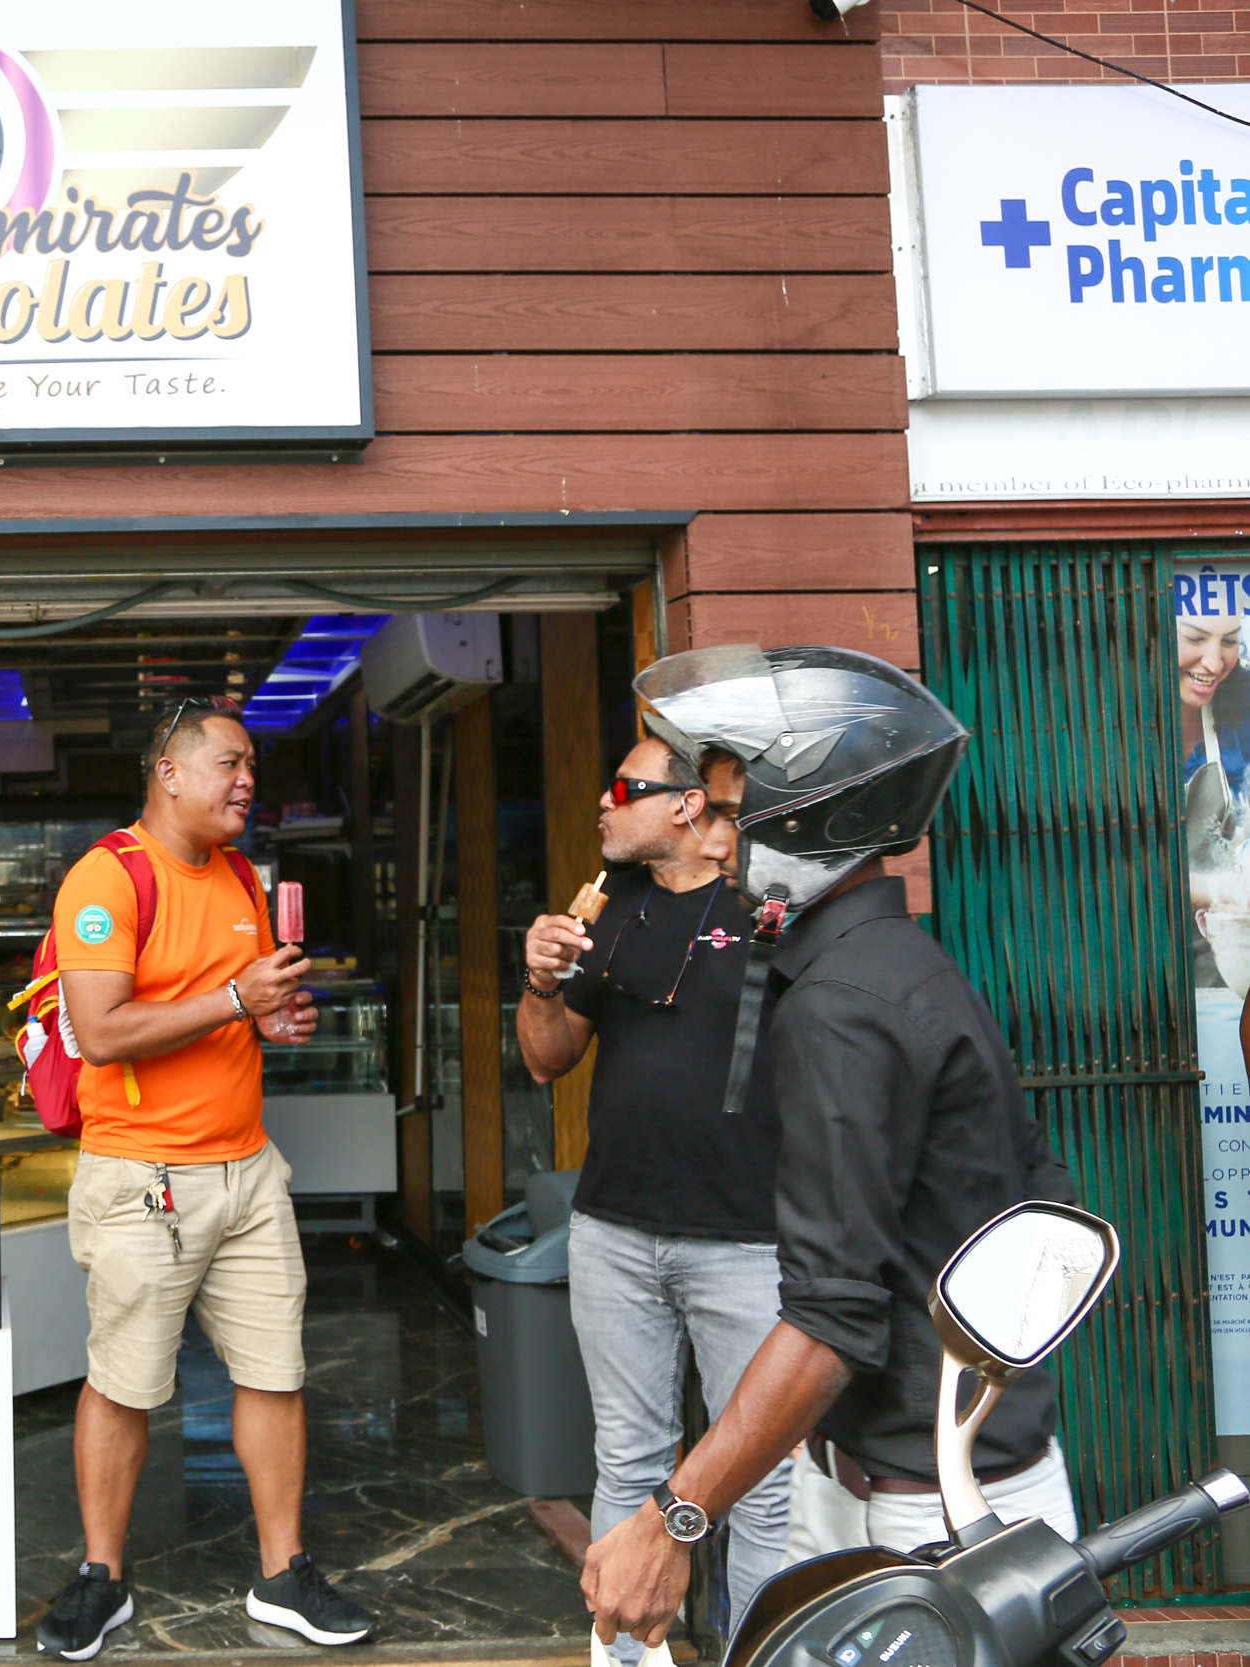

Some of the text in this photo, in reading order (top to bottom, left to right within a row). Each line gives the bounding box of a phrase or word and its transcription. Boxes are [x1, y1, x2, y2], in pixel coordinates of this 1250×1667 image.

[1061, 159, 1250, 242] Capita
[27, 374, 101, 398] Your
[124, 372, 226, 395] Taste.
[940, 476, 1055, 492] member
[1065, 475, 1093, 491] of
[1202, 1105, 1250, 1124] MIN
[879, 1629, 912, 1662] SUZUKI
